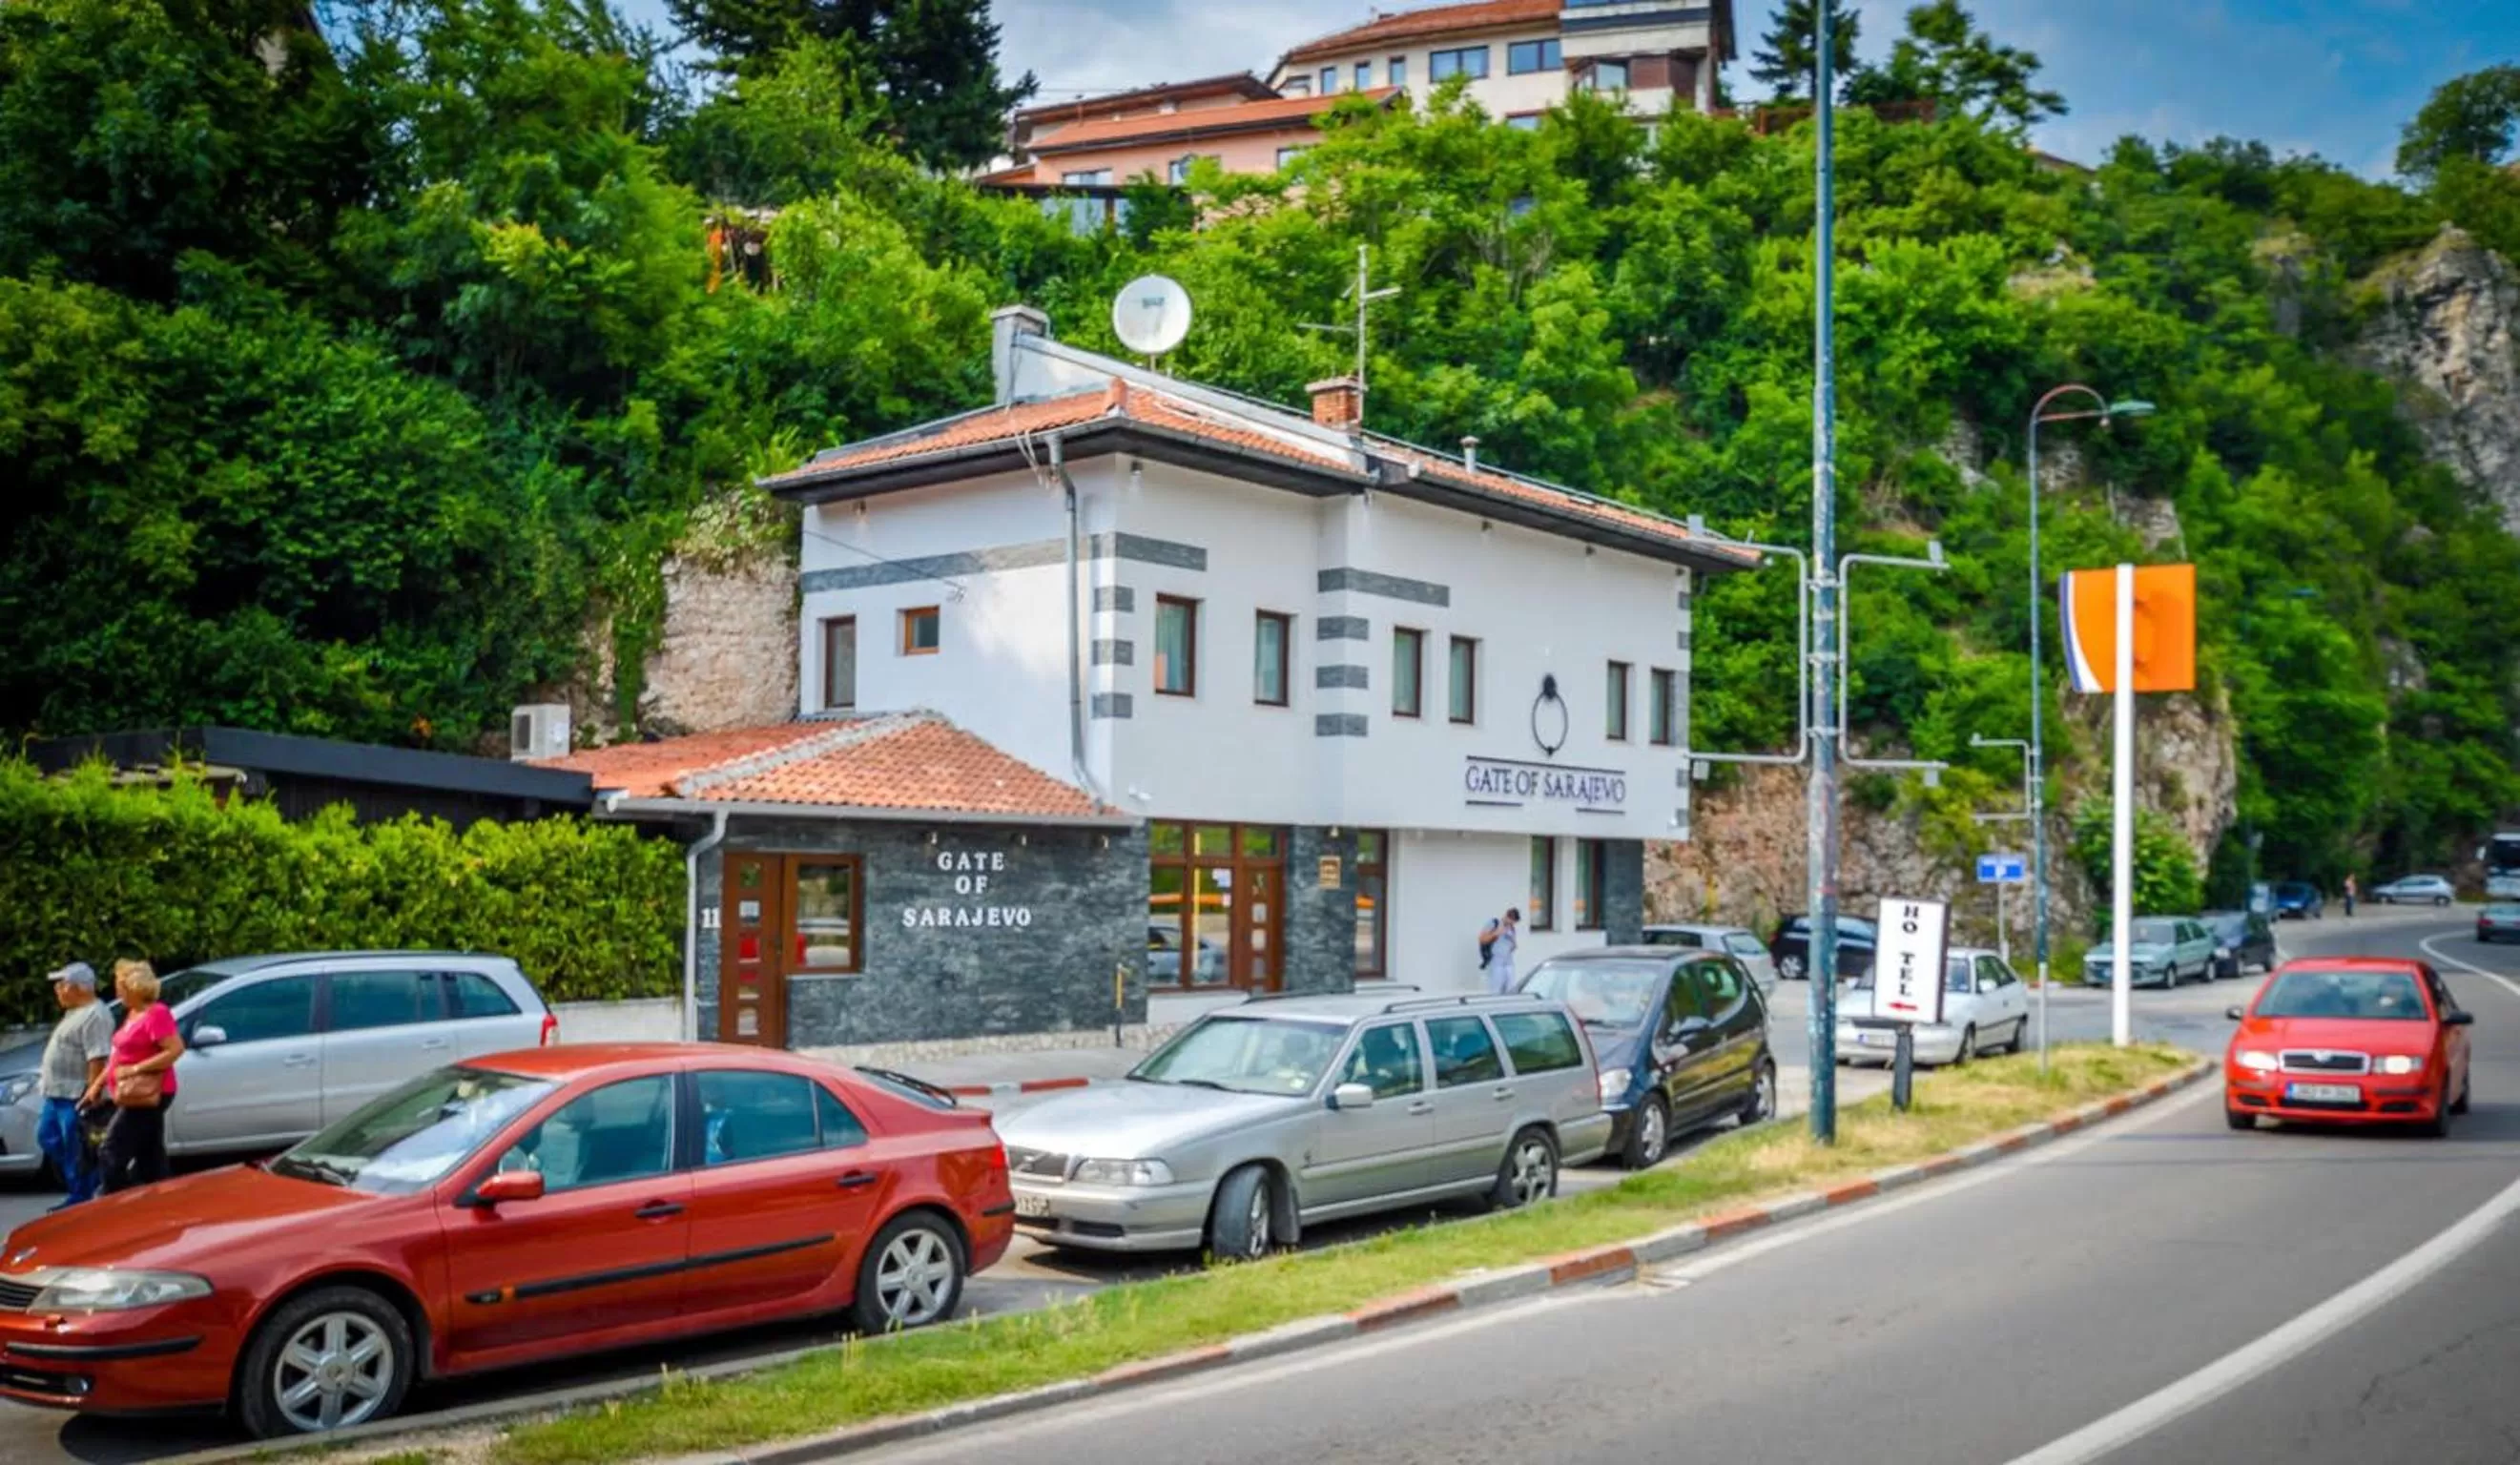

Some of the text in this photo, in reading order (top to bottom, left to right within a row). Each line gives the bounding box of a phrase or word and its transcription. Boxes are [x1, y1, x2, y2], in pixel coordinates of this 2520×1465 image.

[1465, 765, 1625, 804] GATE OF SARAJEVO
[937, 851, 1004, 871] GATE
[955, 875, 988, 895] OF
[701, 907, 722, 928] 11
[902, 907, 1032, 927] SARAJEVO
